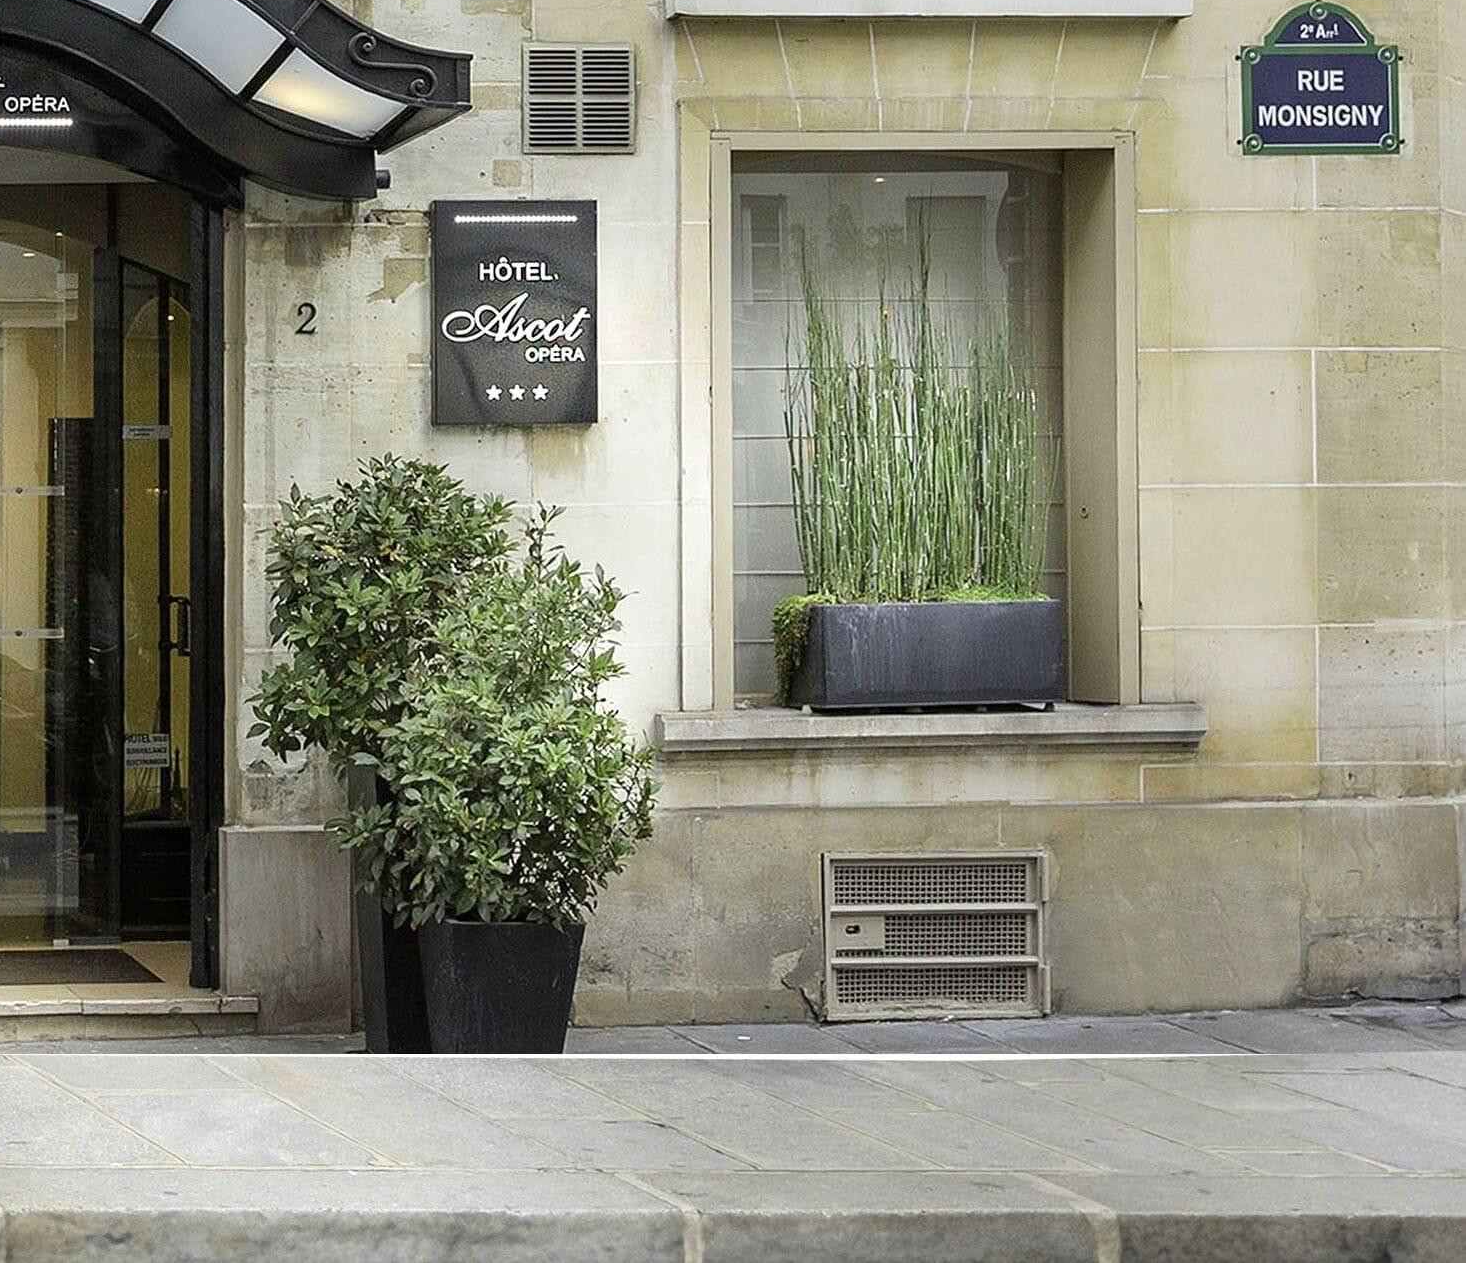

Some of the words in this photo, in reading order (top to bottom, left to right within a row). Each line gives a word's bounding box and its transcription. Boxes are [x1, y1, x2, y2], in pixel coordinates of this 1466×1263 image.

[1297, 69, 1345, 92] RUE
[4, 93, 71, 113] OPÉRA
[1258, 104, 1384, 127] MONSIGNY
[478, 255, 554, 282] HÔTEL
[295, 302, 318, 335] 2
[441, 291, 592, 343] Ascot
[524, 343, 586, 363] OPÉRA
